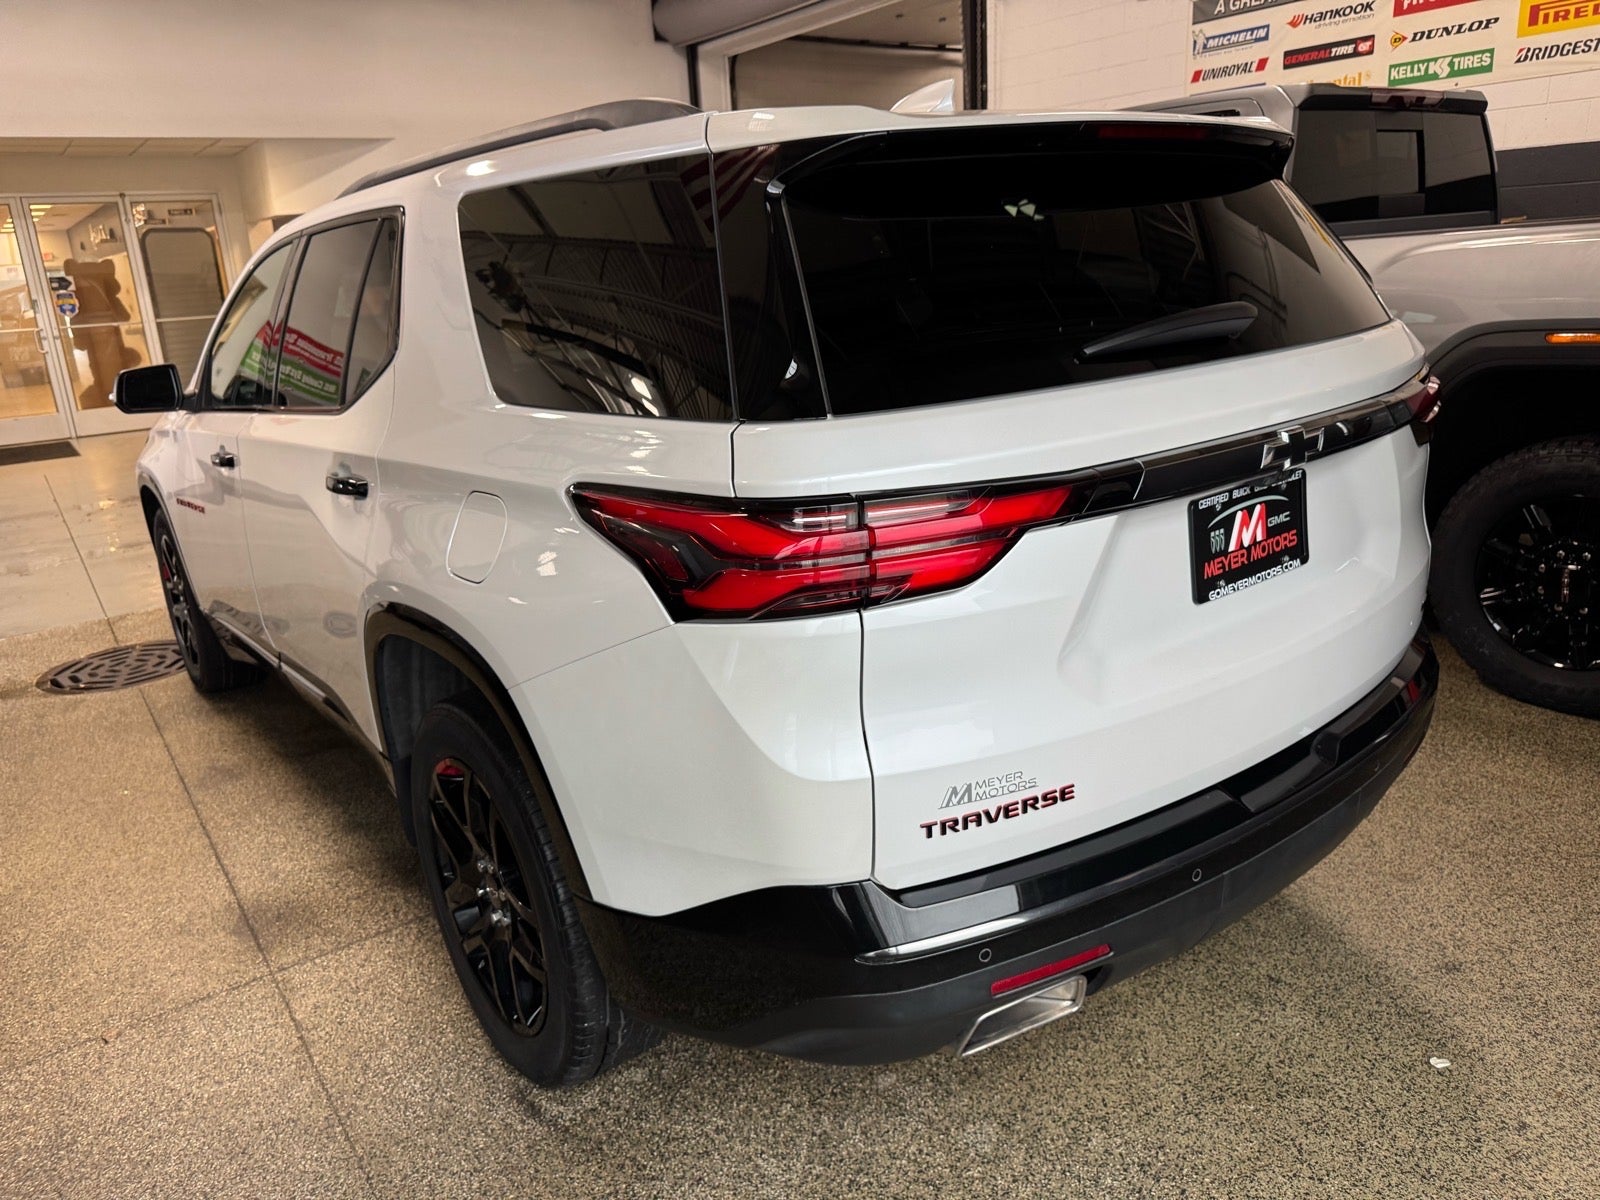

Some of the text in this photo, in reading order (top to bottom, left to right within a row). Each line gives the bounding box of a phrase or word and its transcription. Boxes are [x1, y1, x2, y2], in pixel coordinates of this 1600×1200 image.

[1315, 13, 1375, 29] driving emotion
[1409, 17, 1500, 43] DUNLOP
[1206, 27, 1268, 48] MICHELIN
[1202, 61, 1254, 81] UNIROYAL
[1390, 62, 1428, 80] KELLY
[1452, 52, 1492, 71] TIRES
[1198, 486, 1251, 510] CERTIFIED BUICK
[1267, 511, 1291, 527] GMC
[1204, 529, 1298, 580] MEYER MOTORS
[1208, 558, 1301, 601] GOMEYERMOTORS.COM
[974, 771, 1024, 790] MEYER
[975, 777, 1038, 801] MOTORS
[919, 783, 1075, 839] TRAVERSE
